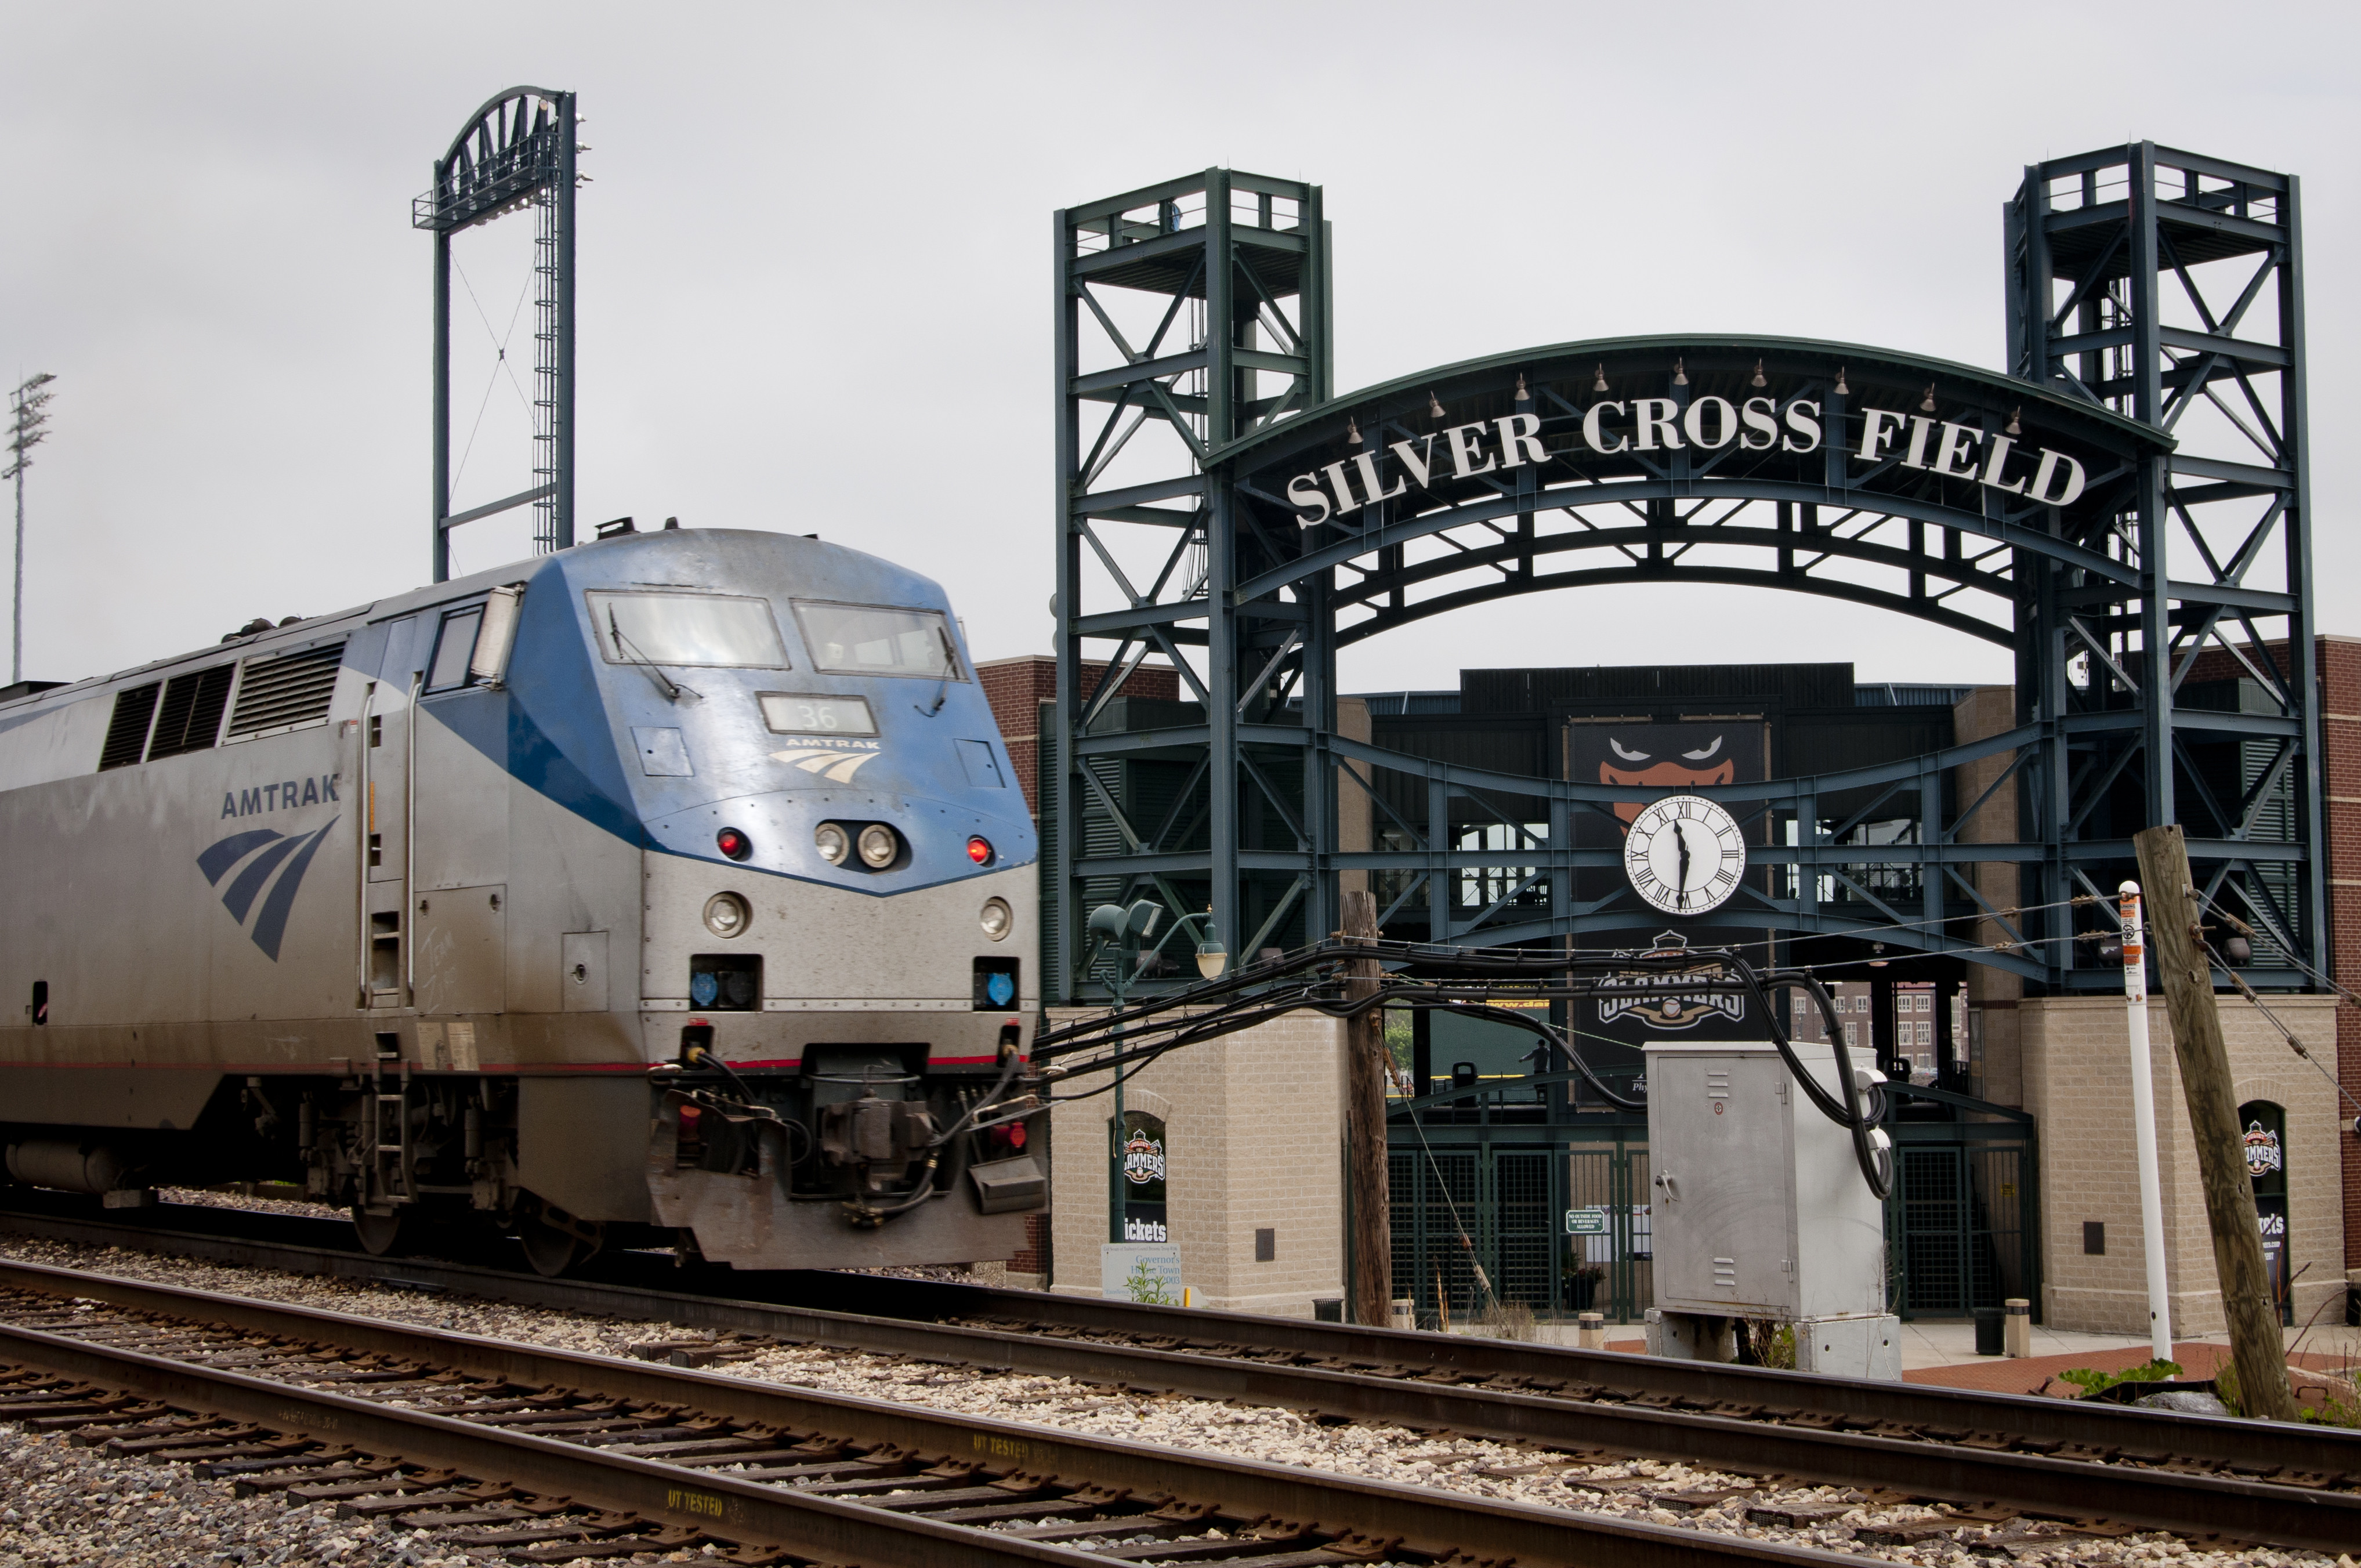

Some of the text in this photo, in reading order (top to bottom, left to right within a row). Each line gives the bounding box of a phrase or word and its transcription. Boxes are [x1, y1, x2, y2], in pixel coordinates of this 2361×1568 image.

[1287, 395, 2086, 530] SILVER CROSS FIELD
[798, 705, 838, 729] 36
[786, 738, 881, 749] AMTRAK
[220, 773, 341, 820] AMTRAK
[1124, 1152, 1164, 1177] AMMERS
[1125, 1218, 1167, 1241] ickets
[1136, 1254, 1180, 1264] Governor's
[1158, 1265, 1180, 1274] Town
[990, 1437, 1029, 1458] TESTED
[668, 1489, 682, 1508] UT
[684, 1492, 722, 1517] TESTED
